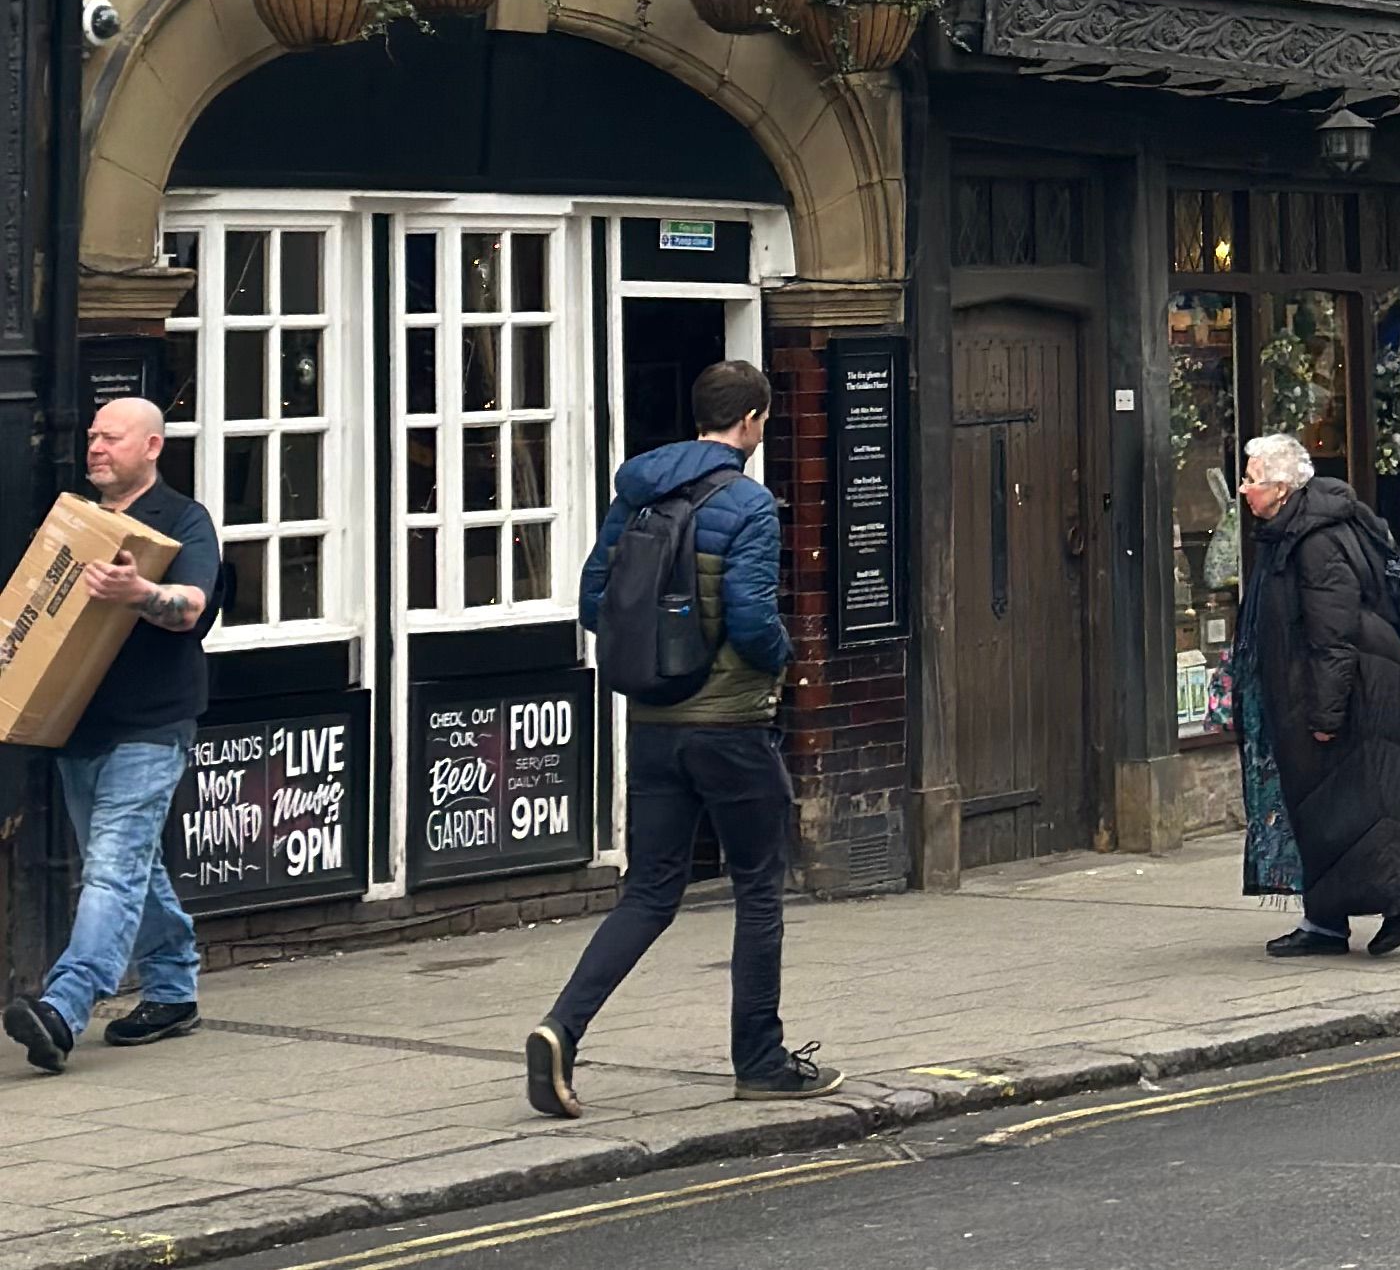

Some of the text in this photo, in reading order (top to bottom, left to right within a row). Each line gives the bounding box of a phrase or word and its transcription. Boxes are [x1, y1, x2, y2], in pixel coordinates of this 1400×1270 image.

[430, 708, 496, 729] CHECK OUT
[450, 731, 478, 748] OUR
[510, 701, 572, 751] FOOD
[286, 725, 345, 777] LIVE
[516, 754, 560, 770] SERVED
[273, 774, 345, 827] Music
[429, 757, 496, 806] Beer
[508, 775, 541, 791] DAILY
[182, 802, 262, 860] HAUNTED
[426, 807, 496, 851] GARDEN
[511, 796, 568, 840] 9PM
[200, 858, 243, 886] INN
[287, 824, 342, 877] 9PM
